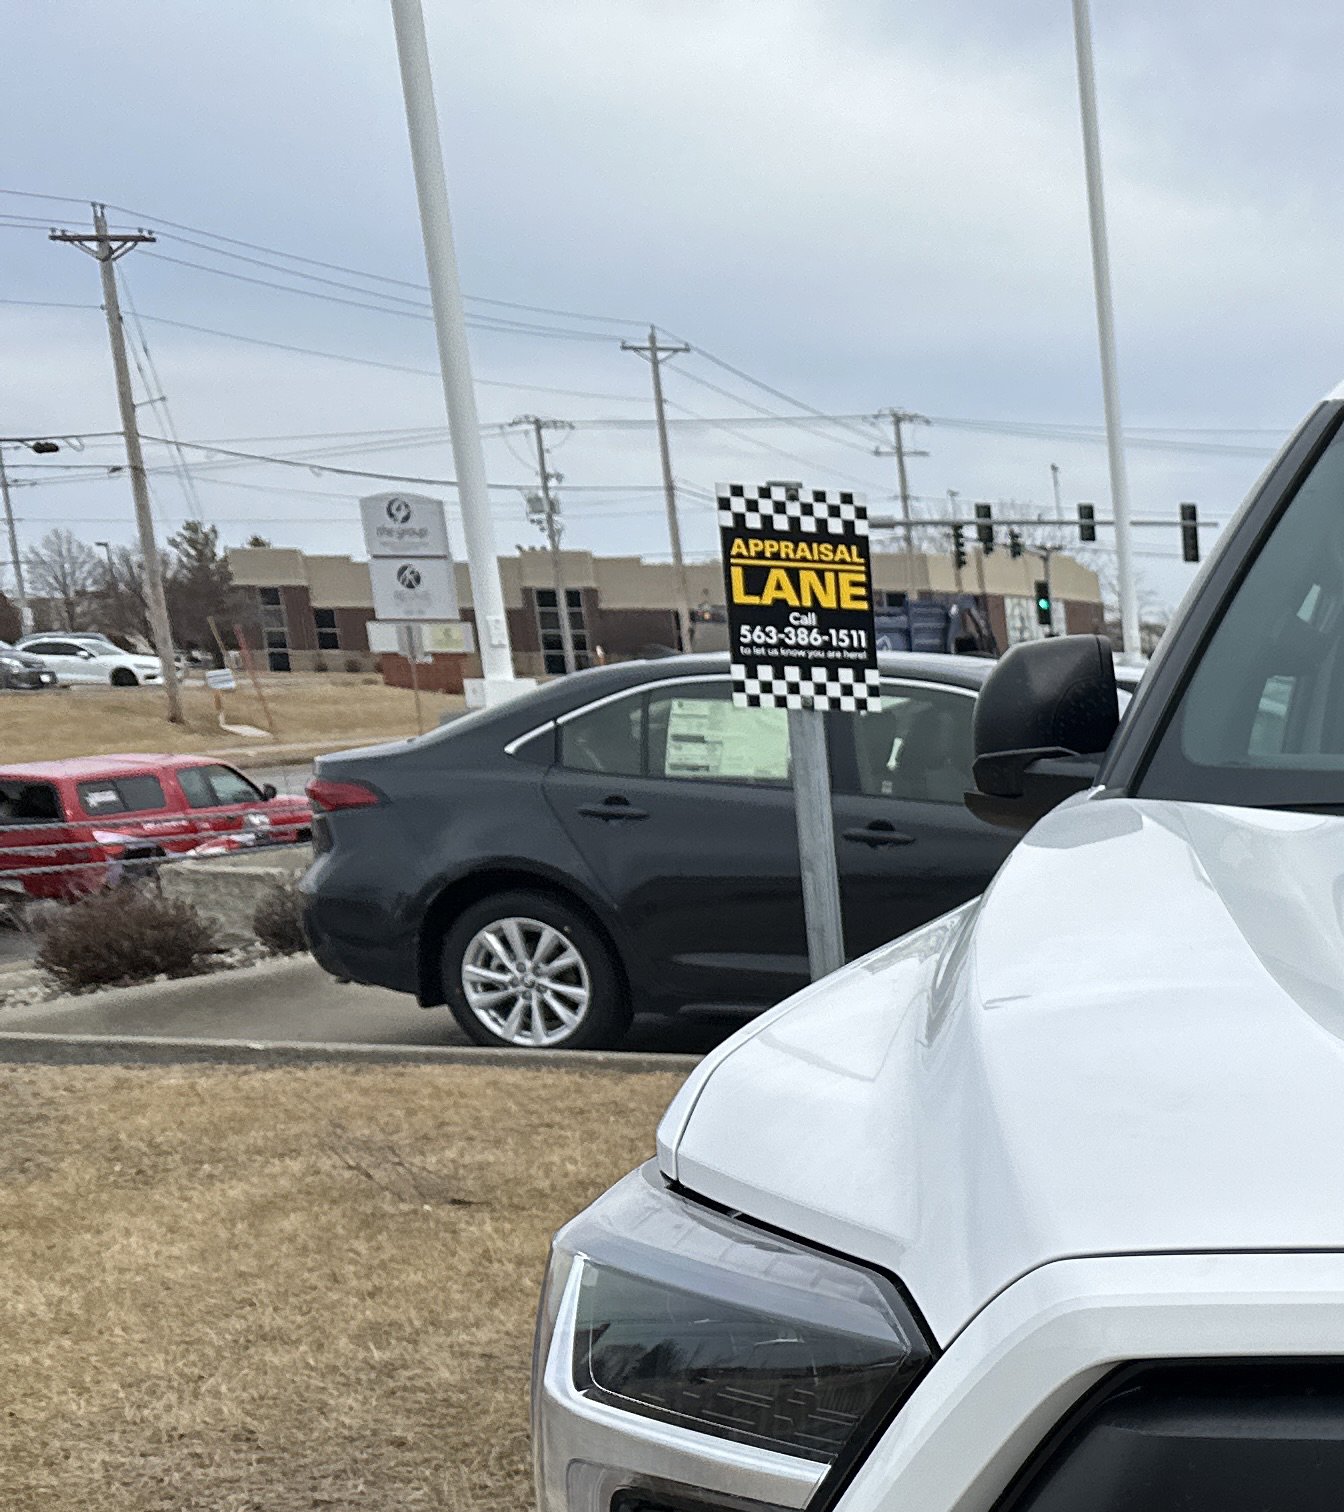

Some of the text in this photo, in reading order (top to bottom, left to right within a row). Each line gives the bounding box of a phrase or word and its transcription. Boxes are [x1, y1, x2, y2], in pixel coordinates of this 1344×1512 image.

[730, 537, 866, 564] APPRAISAL
[730, 566, 870, 611] LANE
[788, 611, 817, 627] Call
[739, 624, 867, 649] 563-386-1511
[740, 645, 867, 660] to let us know you are here!
